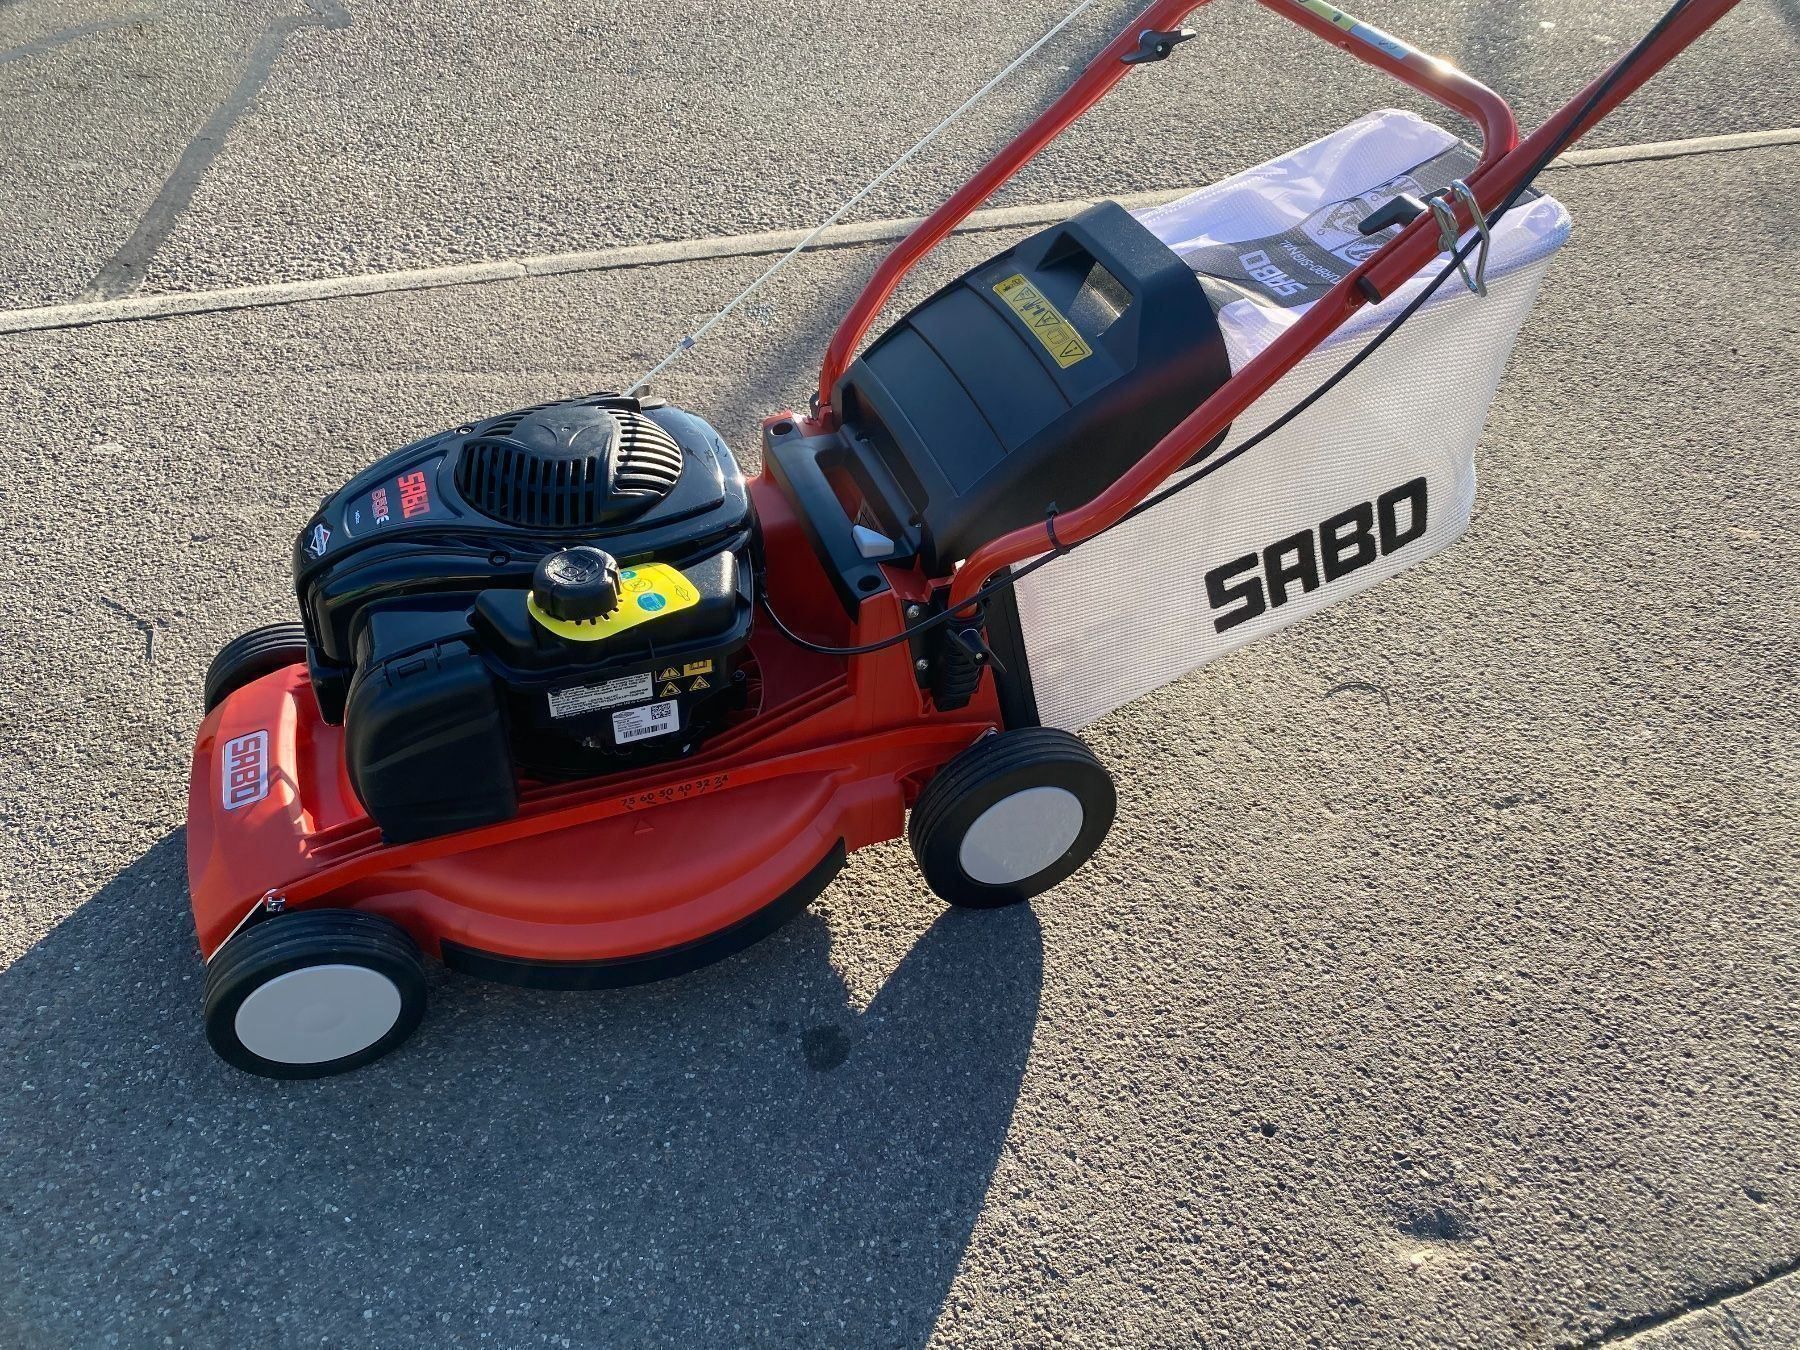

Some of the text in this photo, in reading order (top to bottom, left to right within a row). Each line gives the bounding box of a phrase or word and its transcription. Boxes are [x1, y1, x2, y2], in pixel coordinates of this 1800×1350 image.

[1238, 249, 1308, 297] SABO
[1280, 239, 1342, 285] URBO-SIGNAL
[397, 471, 431, 519] SABO
[1203, 476, 1428, 634] SABO
[230, 736, 261, 804] SABO
[620, 774, 729, 807] 75 60 50 40 32 24
